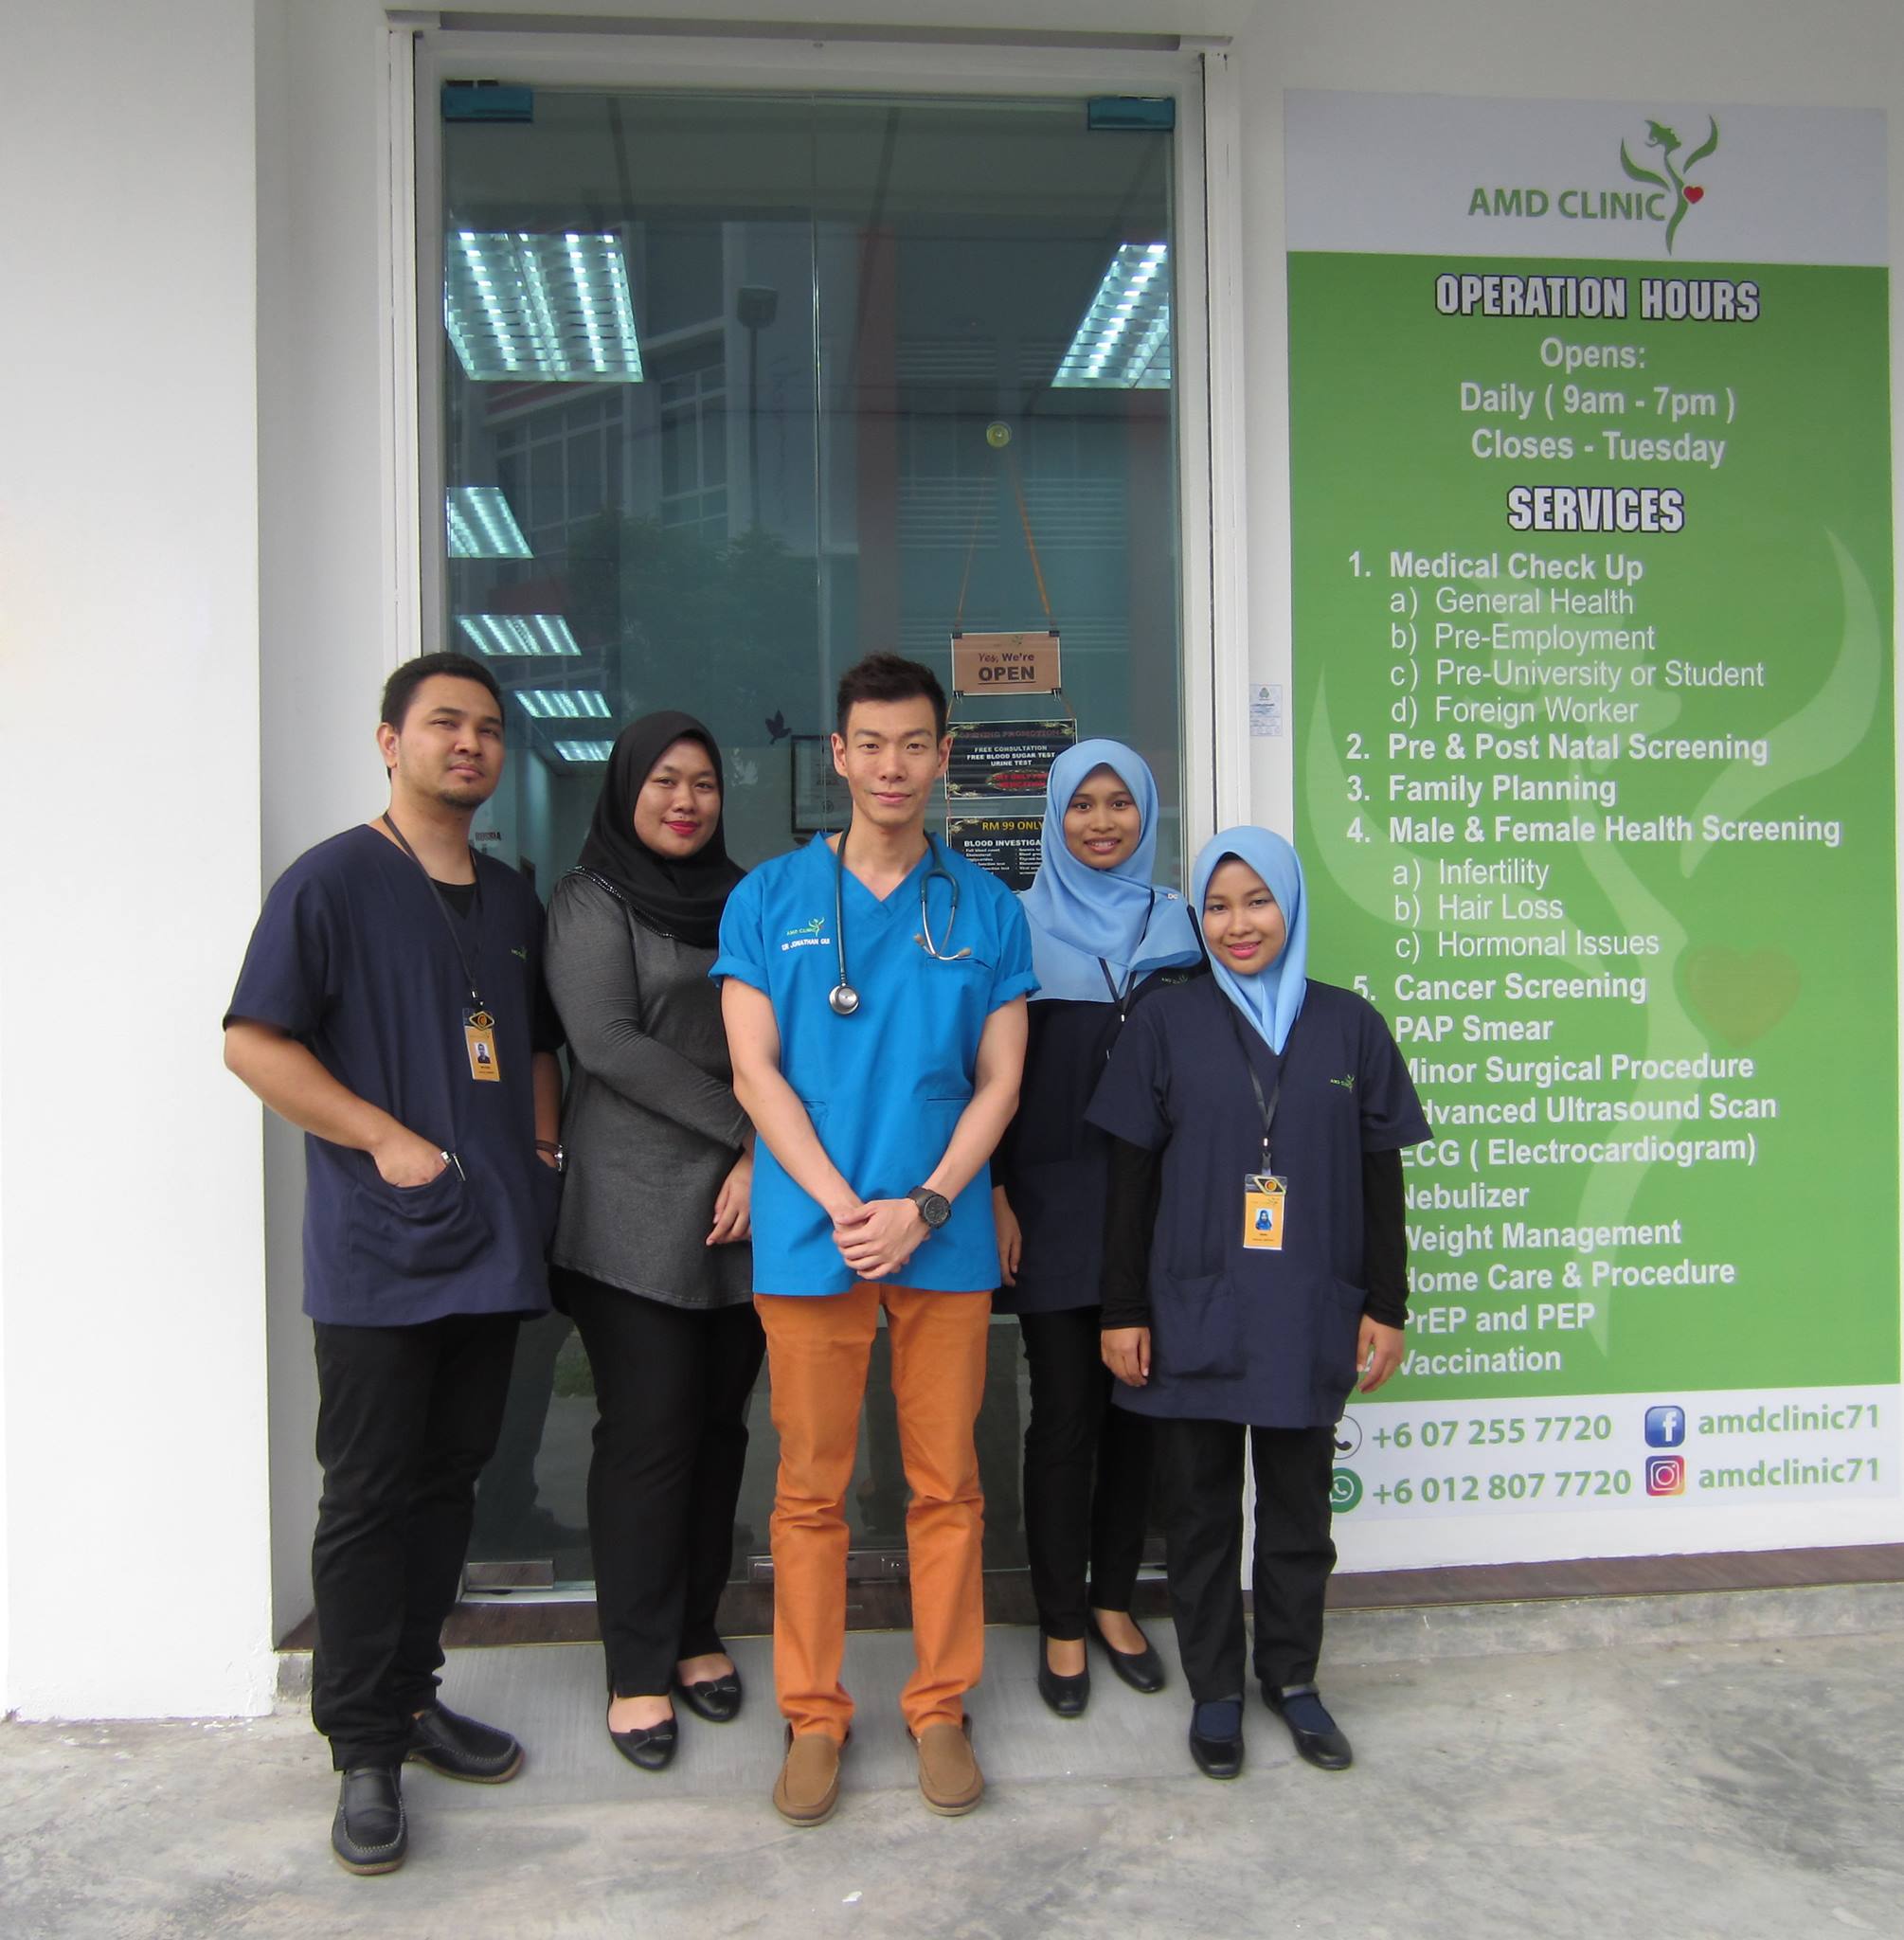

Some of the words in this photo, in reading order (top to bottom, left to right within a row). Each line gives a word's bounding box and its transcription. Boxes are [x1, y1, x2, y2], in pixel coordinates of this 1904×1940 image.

[1467, 189, 1549, 217] AMD
[1558, 190, 1666, 221] CLINIC
[1435, 274, 1626, 318] OPERATION
[1641, 279, 1760, 322] HOURS
[1540, 337, 1646, 373] Opens:
[1461, 383, 1533, 419] Daily
[1563, 386, 1625, 414] 9am
[1654, 386, 1716, 422] 7pm
[1472, 429, 1573, 459] Closes
[1604, 432, 1725, 469] Tuesday
[1507, 486, 1685, 532] SERVICES
[1349, 553, 1371, 577] 1.
[1391, 552, 1499, 578] Medical
[1508, 554, 1595, 579] Check
[1607, 555, 1644, 584] Up
[1391, 588, 1418, 618] a)
[1436, 588, 1540, 614] General
[1551, 589, 1634, 615] Health
[1392, 624, 1418, 654] b)
[1435, 624, 1655, 655] Pre-Employment
[978, 654, 999, 663] Yes,
[1002, 653, 1034, 661] We're
[978, 666, 1035, 681] OPEN
[1391, 661, 1418, 691] c)
[1437, 660, 1622, 691] Pre-University
[1631, 666, 1656, 686] or
[1665, 660, 1764, 687] Student
[1392, 697, 1418, 726] d)
[1436, 697, 1535, 727] Foreign
[1545, 698, 1639, 723] Worker
[1347, 735, 1370, 760] 2.
[1390, 734, 1436, 759] Pre
[1446, 735, 1465, 759] &
[1476, 734, 1538, 759] Post
[1549, 734, 1619, 760] Natal
[1628, 734, 1768, 764] Screening
[1347, 777, 1370, 800] 3.
[1390, 776, 1482, 806] Family
[1493, 775, 1616, 805] Planning
[982, 821, 999, 831] RM
[1002, 821, 1015, 830] 99
[1347, 819, 1371, 842] 4.
[1390, 817, 1455, 842] Male
[1464, 817, 1484, 842] &
[1495, 817, 1595, 841] Female
[1606, 817, 1693, 841] Health
[1701, 816, 1841, 846] Screening
[1392, 862, 1421, 889] a)
[1440, 860, 1550, 889] Infertility
[1394, 895, 1421, 925] b)
[1439, 895, 1492, 920] Hair
[1502, 894, 1563, 919] Loss
[1396, 933, 1420, 961] c)
[1439, 932, 1568, 958] Hormonal
[1576, 931, 1660, 956] Issues
[1353, 976, 1376, 1001] 5.
[1394, 974, 1496, 1002] Cancer
[1505, 972, 1647, 1003] Screening
[1395, 1016, 1453, 1043] PAP
[1463, 1015, 1554, 1041] Smear
[1485, 1056, 1601, 1088] Surgical
[1611, 1053, 1753, 1080] Procedure
[1546, 1095, 1699, 1121] Ultrasound
[1709, 1093, 1776, 1119] Scan
[1401, 1140, 1460, 1167] ECG
[1489, 1134, 1757, 1167] Electrocardiogram)
[1501, 1220, 1682, 1251] Management
[1487, 1266, 1553, 1291] Care
[1562, 1266, 1581, 1288] &
[1592, 1262, 1735, 1287] Procedure
[1476, 1307, 1528, 1332] and
[1537, 1304, 1595, 1330] PEP
[1373, 1422, 1413, 1447] +6
[1421, 1421, 1459, 1446] 07
[1468, 1419, 1525, 1445] 255
[1536, 1416, 1611, 1442] 7720
[1698, 1404, 1879, 1434] amdclinic71
[1373, 1479, 1413, 1503] +6
[1421, 1476, 1479, 1501] 012
[1488, 1473, 1545, 1499] 807
[1556, 1470, 1631, 1497] 7720
[1698, 1458, 1879, 1489] amdclinic71
